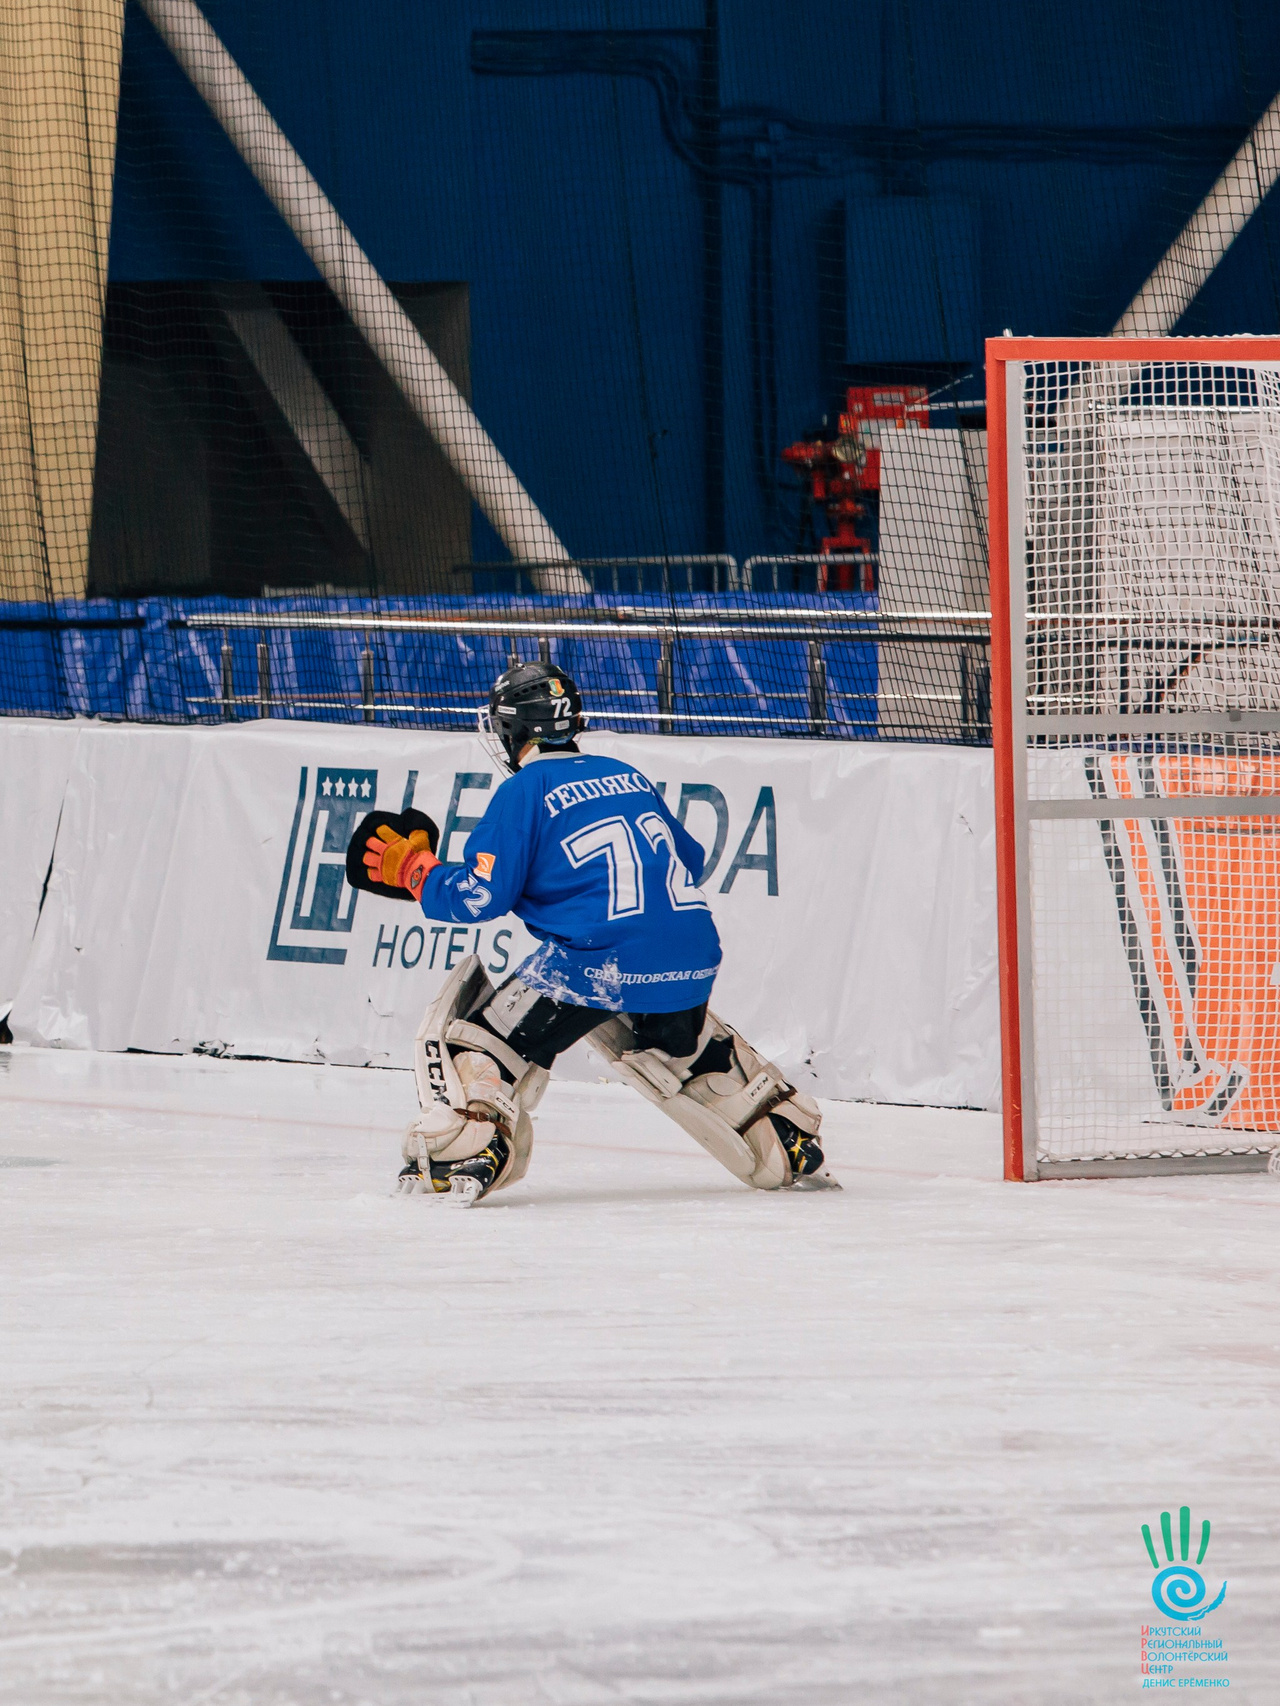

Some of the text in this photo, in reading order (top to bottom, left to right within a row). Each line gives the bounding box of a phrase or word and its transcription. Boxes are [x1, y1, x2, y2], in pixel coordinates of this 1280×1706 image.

[551, 697, 573, 719] 72
[544, 772, 656, 819] ТЕПЛЯКО
[560, 811, 713, 922] 72
[425, 1039, 452, 1106] CCM
[750, 1076, 770, 1098] CCM
